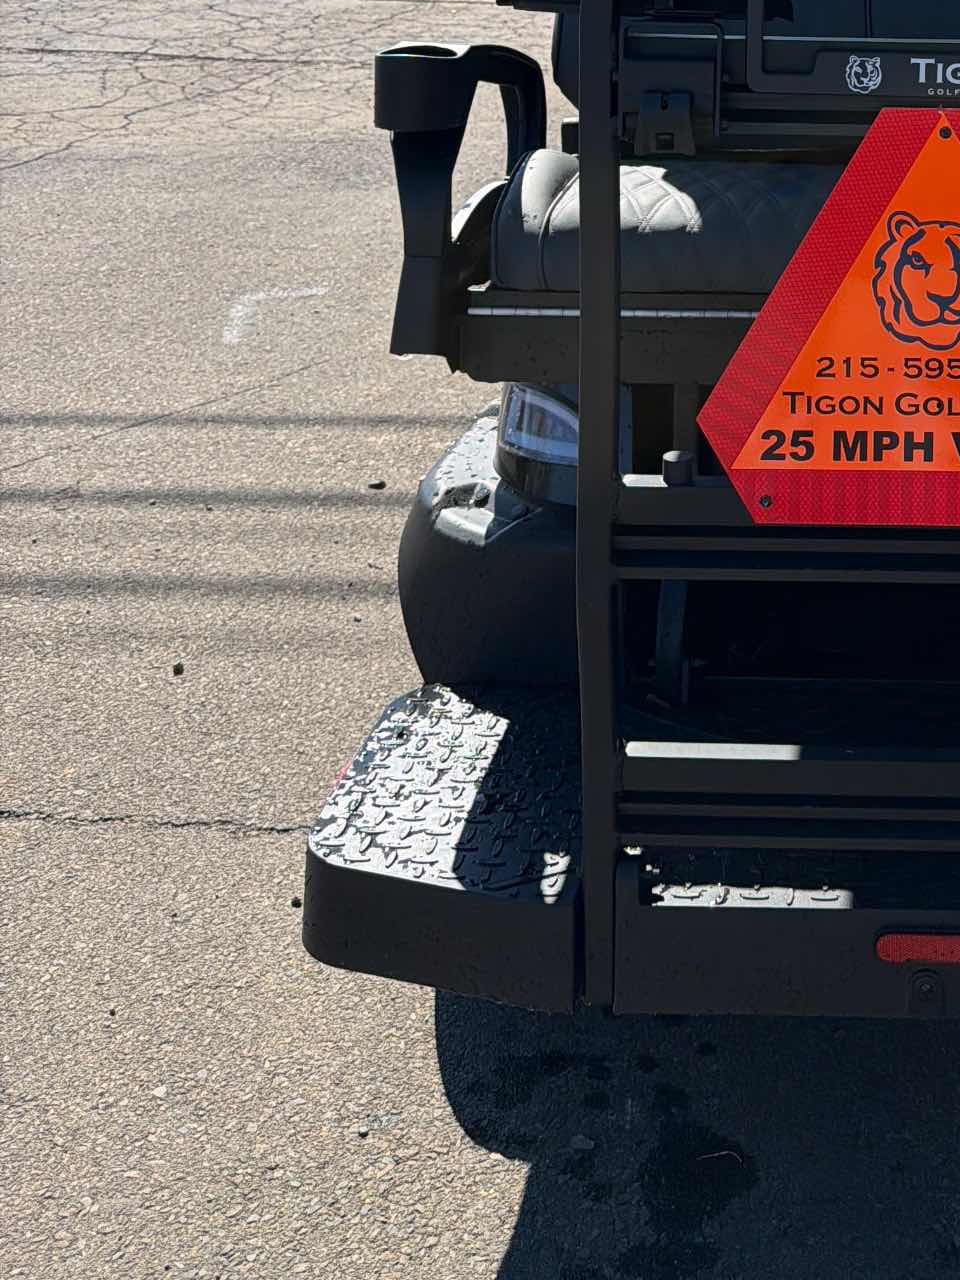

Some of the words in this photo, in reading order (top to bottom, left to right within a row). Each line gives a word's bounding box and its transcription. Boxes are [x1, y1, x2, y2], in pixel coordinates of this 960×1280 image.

[927, 88, 960, 96] GOLF
[759, 430, 814, 462] 25
[832, 430, 935, 463] MPH
